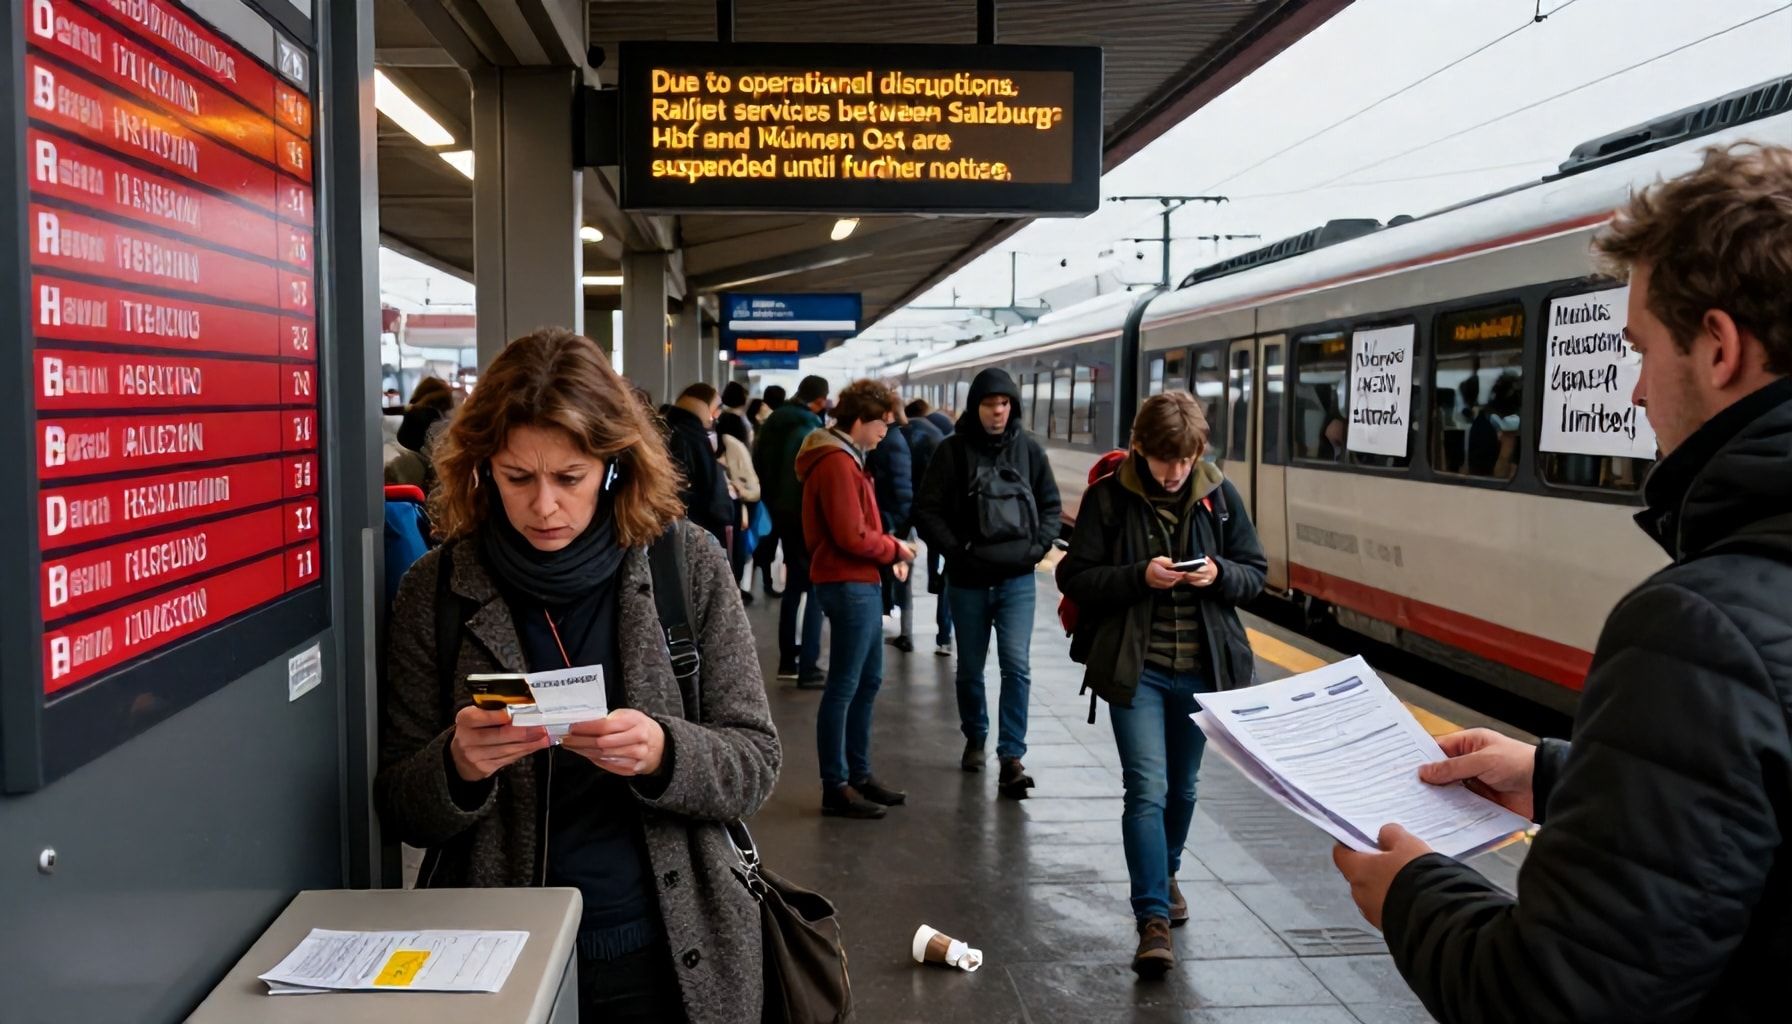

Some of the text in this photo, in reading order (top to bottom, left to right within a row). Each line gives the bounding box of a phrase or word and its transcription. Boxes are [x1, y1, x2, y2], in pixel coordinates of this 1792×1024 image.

[652, 69, 699, 93] Due
[706, 72, 731, 93] to
[652, 122, 699, 148] Hbf
[703, 126, 750, 149] and
[911, 133, 951, 150] are
